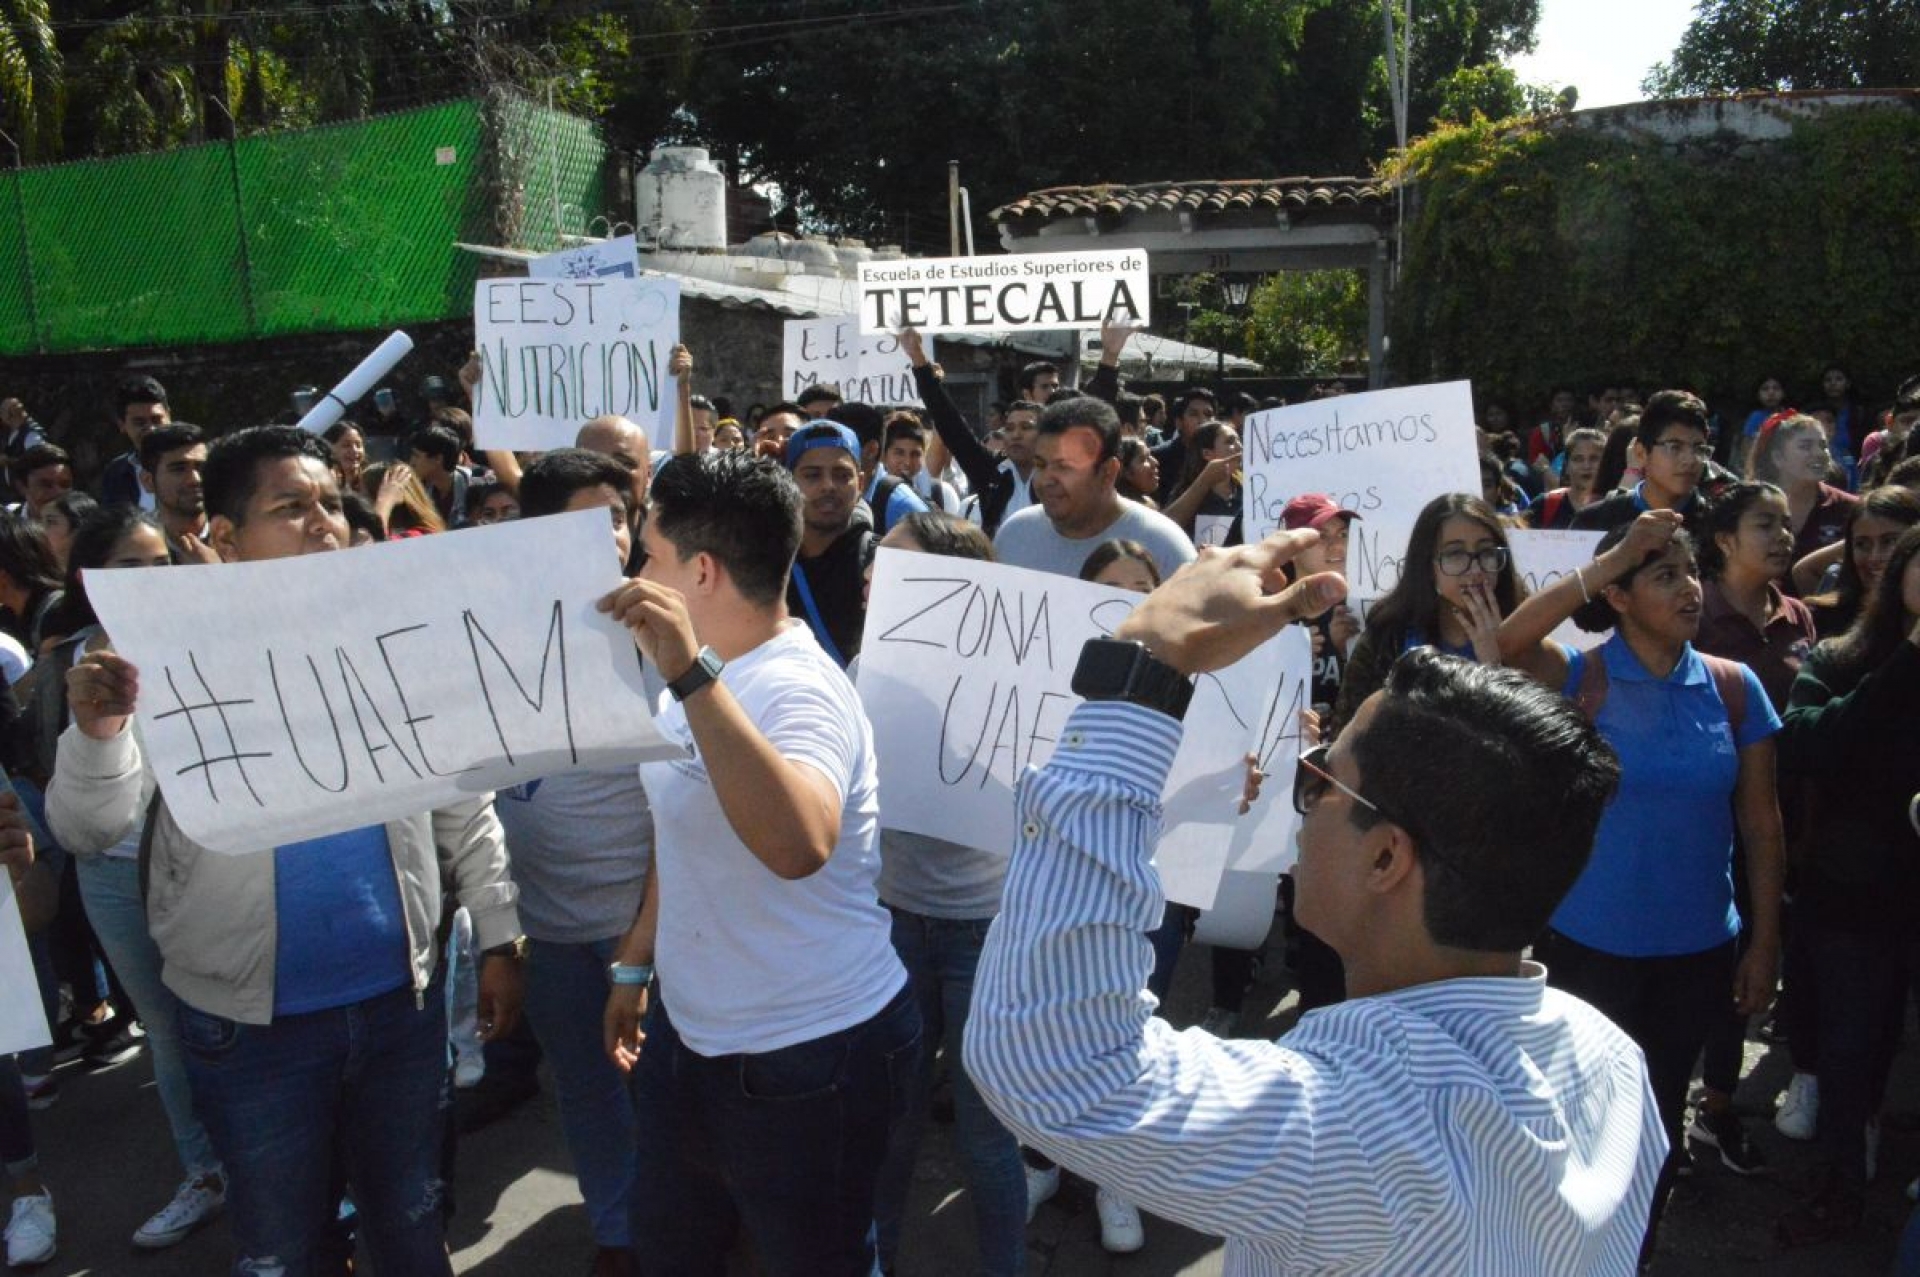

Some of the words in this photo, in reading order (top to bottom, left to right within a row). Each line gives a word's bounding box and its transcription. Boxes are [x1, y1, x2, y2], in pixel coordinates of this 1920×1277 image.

[863, 265, 920, 282] Escuela
[926, 264, 944, 279] de
[951, 261, 1018, 278] Estudios
[1023, 259, 1114, 277] Superiores
[1120, 256, 1141, 271] de
[489, 282, 605, 326] EEST
[865, 279, 1141, 328] TETECALA
[1250, 410, 1437, 465] Necesitamos
[878, 578, 1053, 672] ZONA
[153, 599, 578, 807] #UAEM
